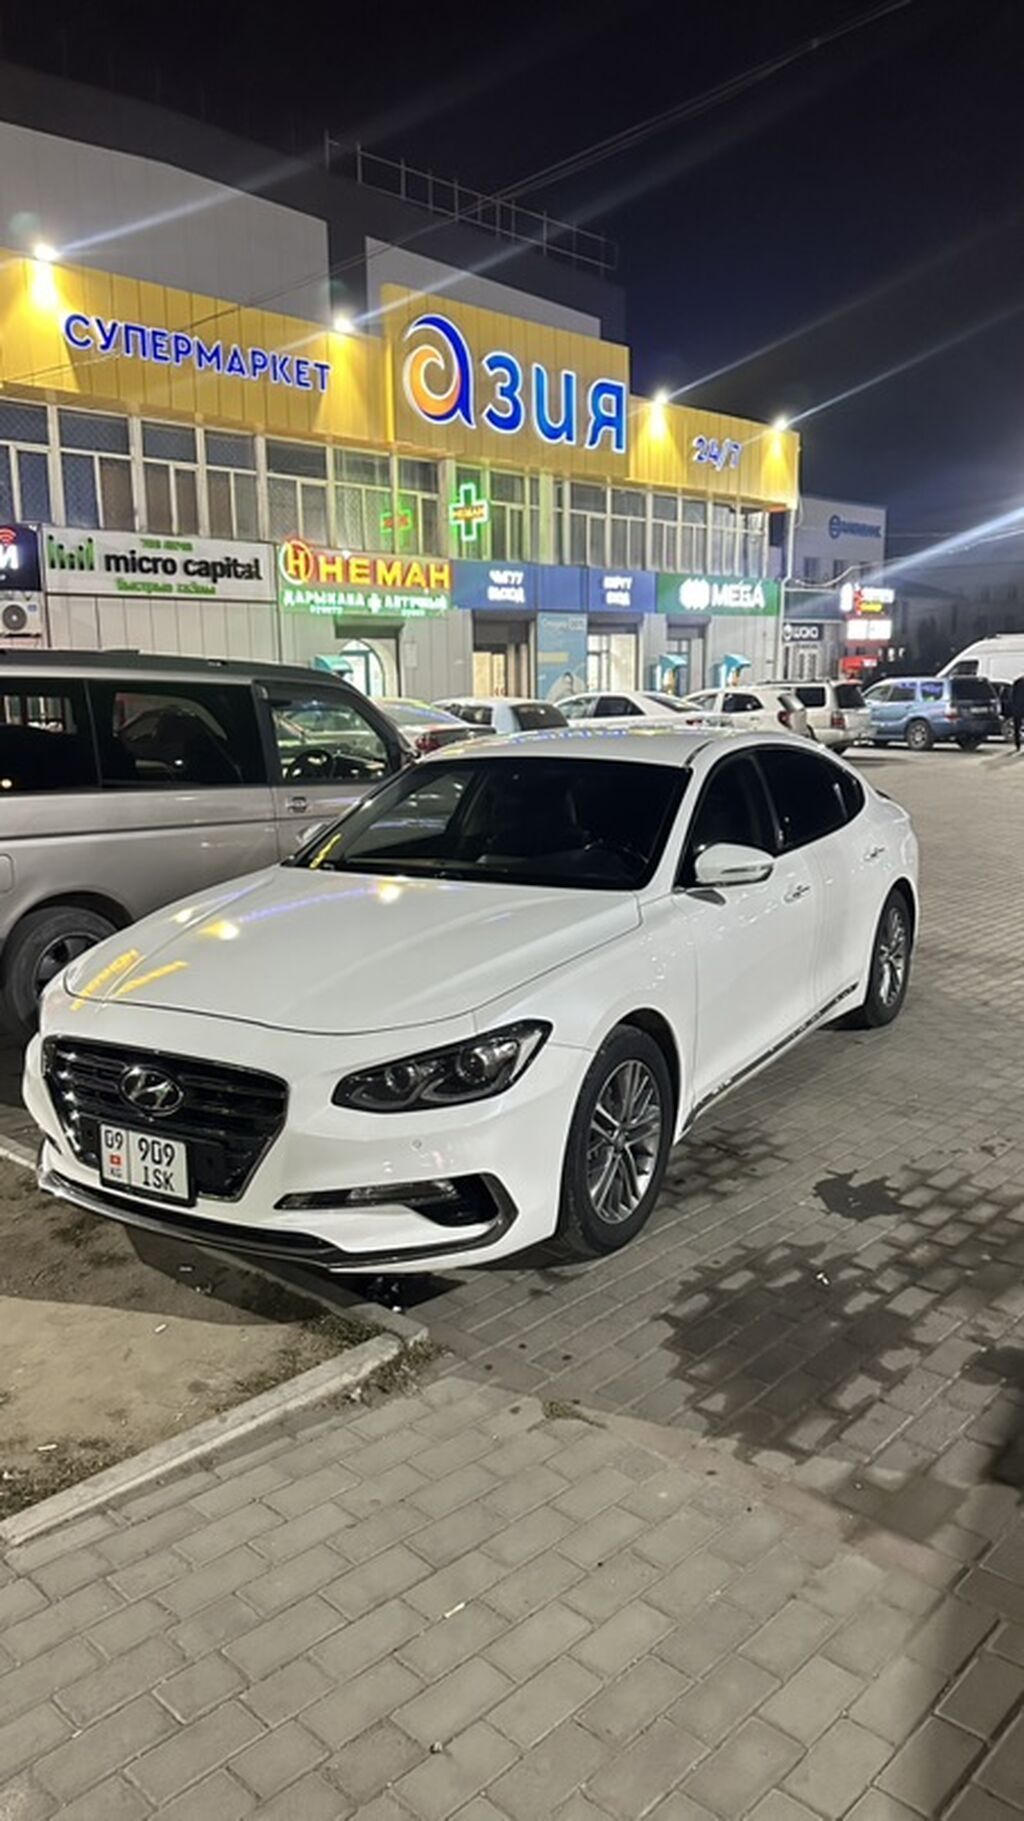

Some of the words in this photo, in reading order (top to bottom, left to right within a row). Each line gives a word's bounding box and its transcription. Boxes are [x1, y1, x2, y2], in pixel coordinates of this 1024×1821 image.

[63, 312, 332, 394] СУПЕРМАРКЕТ
[692, 436, 742, 470] 24/7
[104, 550, 178, 576] micro
[182, 556, 263, 584] capital
[318, 554, 450, 591] НЕМАН
[104, 1129, 123, 1150] 09
[137, 1137, 175, 1167] 909
